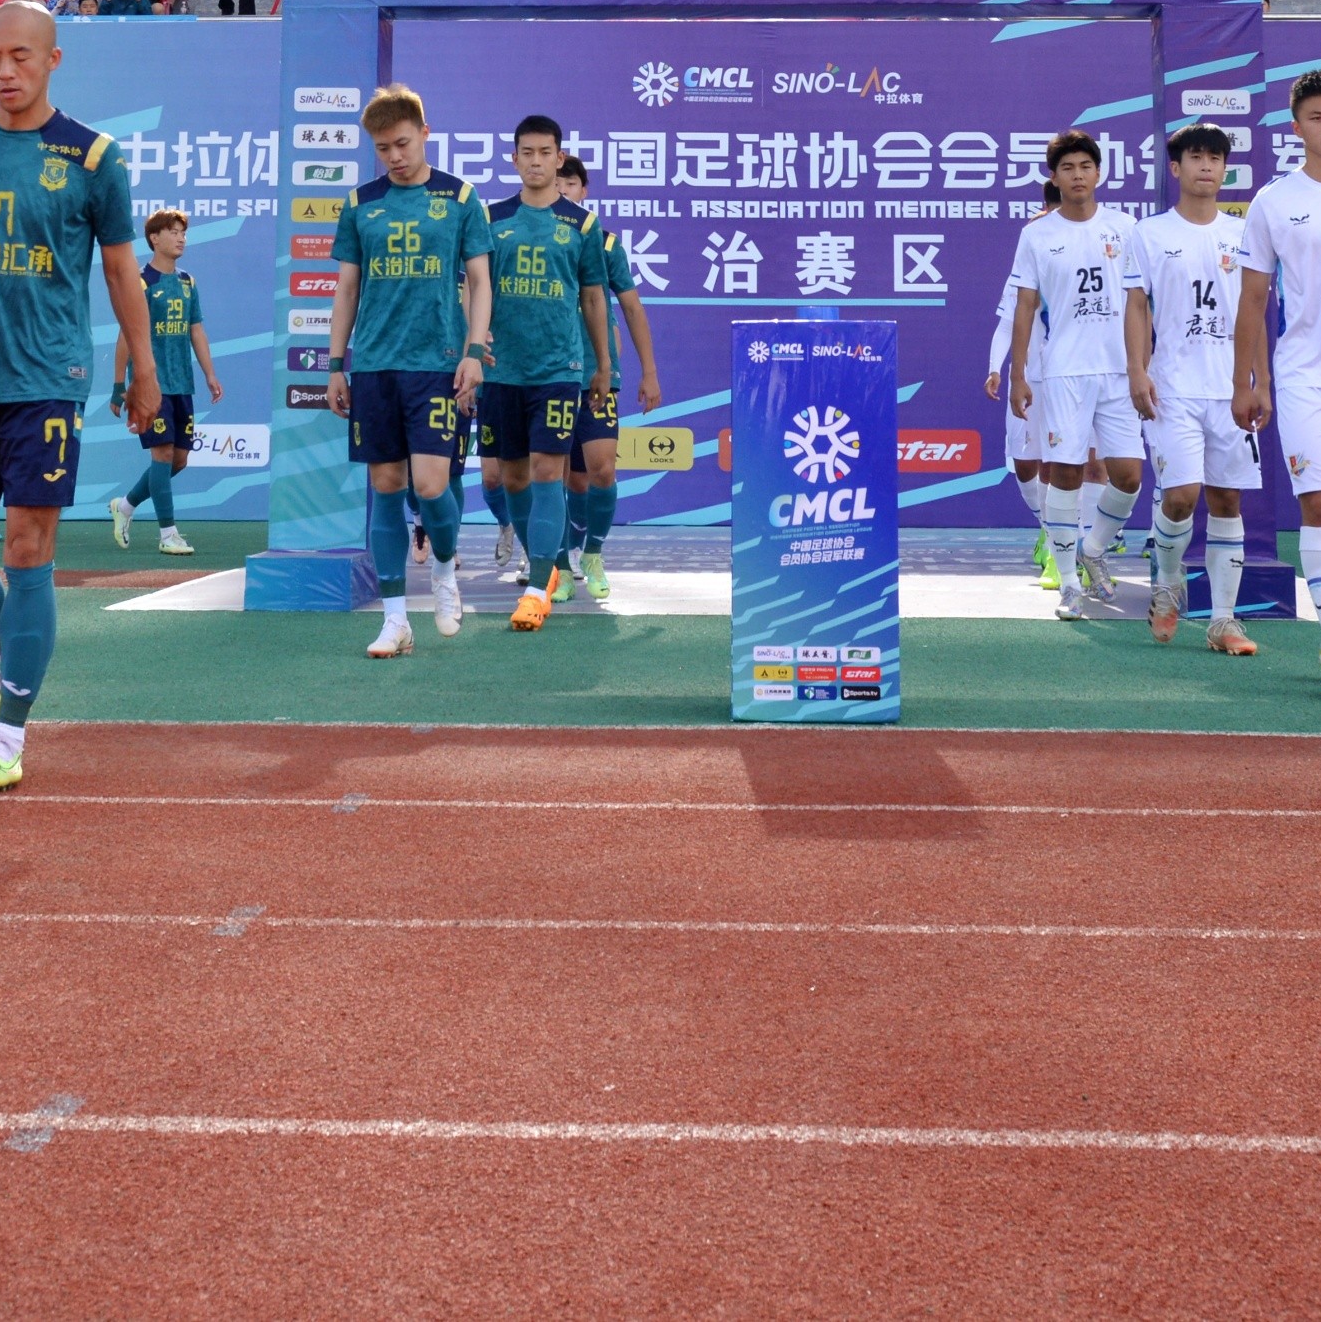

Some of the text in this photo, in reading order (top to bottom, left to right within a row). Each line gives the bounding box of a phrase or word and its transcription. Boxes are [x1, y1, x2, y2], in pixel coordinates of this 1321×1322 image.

[684, 67, 754, 88] CMCL
[772, 66, 901, 97] SINO-LAC
[299, 94, 347, 105] SINO-LAC
[874, 92, 923, 104] 中拉体育
[1187, 96, 1236, 108] SINO-LAC
[691, 200, 864, 219] ASSOCIATION
[875, 199, 998, 218] MEMBER
[387, 221, 421, 253] 26
[369, 255, 441, 277] 长治汇承
[516, 245, 546, 275] 66
[620, 229, 948, 296] 长治赛区
[296, 278, 339, 291] sta
[499, 277, 564, 297] 长治汇承
[1076, 267, 1103, 294] 25
[1192, 280, 1217, 310] 14
[167, 298, 183, 319] 29
[1073, 297, 1111, 318] 君道
[1185, 314, 1227, 338] 君道
[771, 343, 804, 354] CMCL
[812, 344, 872, 358] SINO-LAC
[429, 397, 457, 431] 26
[546, 399, 575, 429] 66
[43, 418, 67, 463] 7
[192, 435, 246, 455] O-LAC
[768, 487, 876, 527] CMCL
[790, 536, 855, 552] 中国足球协会
[780, 548, 865, 566] 会员协会冠军联赛
